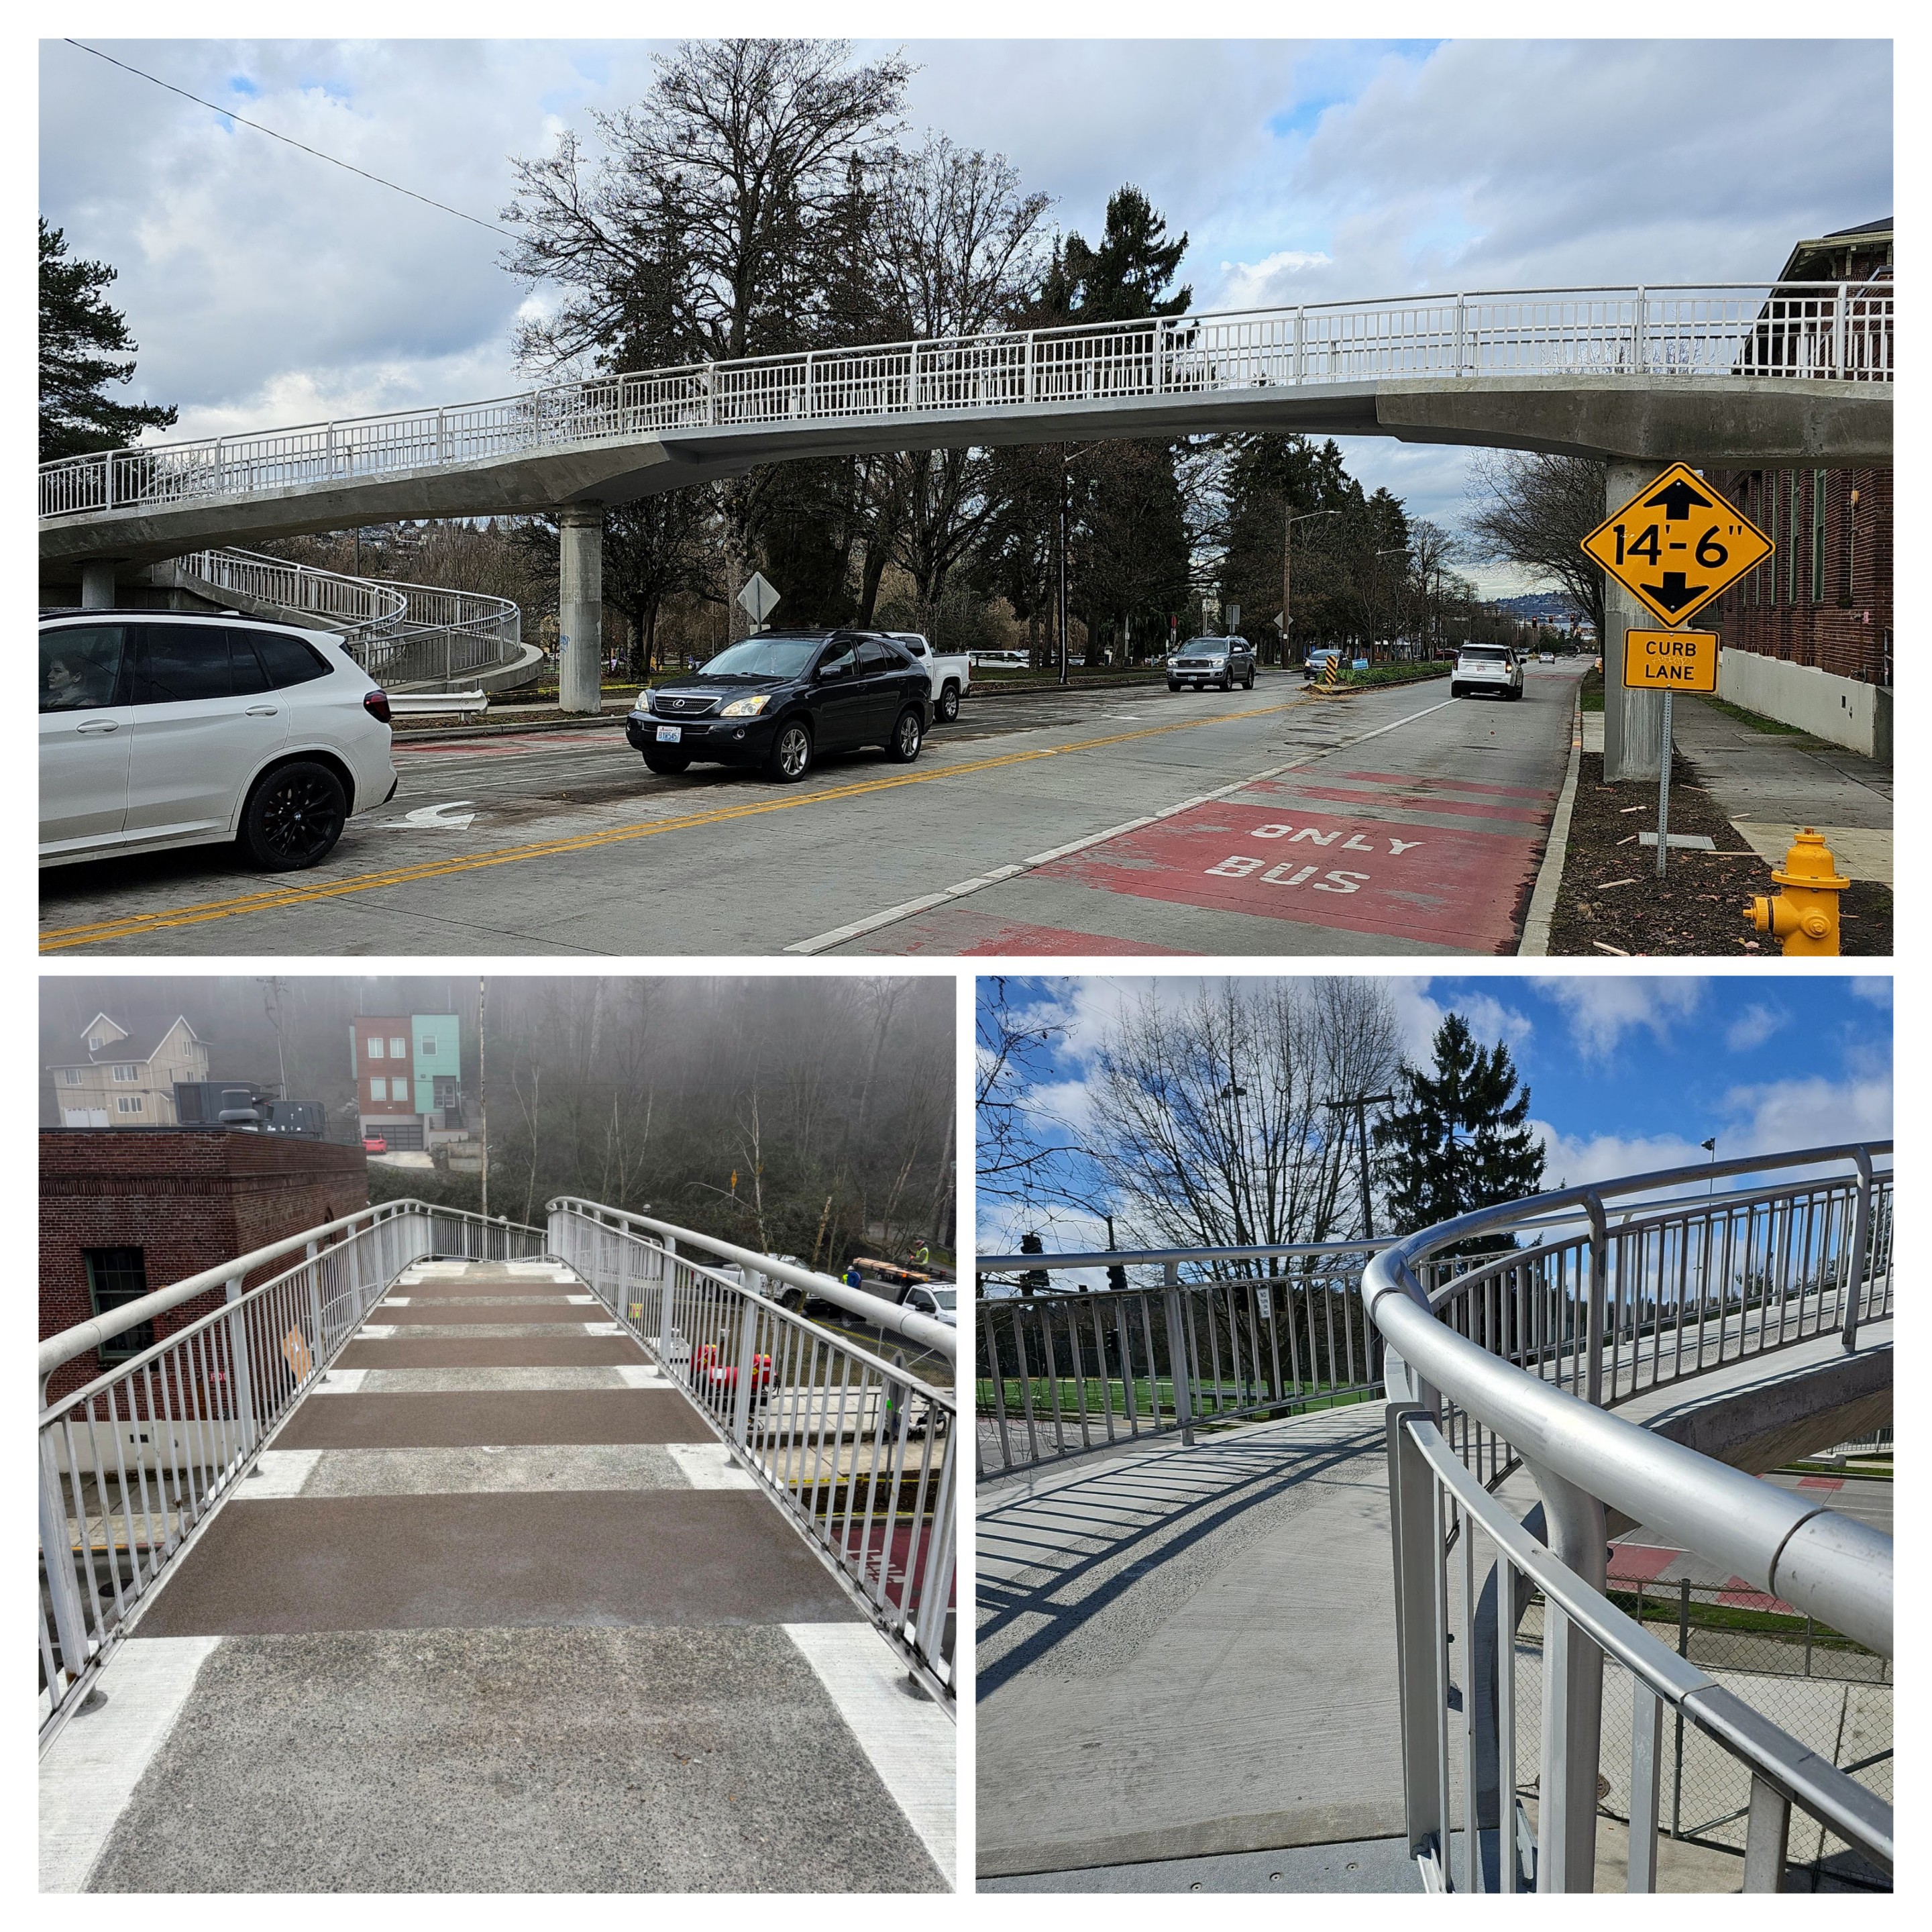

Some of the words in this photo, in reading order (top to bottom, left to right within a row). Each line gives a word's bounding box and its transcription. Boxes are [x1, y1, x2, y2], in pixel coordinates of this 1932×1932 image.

[1646, 641, 1697, 657] CURB
[1645, 664, 1695, 680] LANE
[1250, 824, 1427, 855] ONLY
[1203, 855, 1371, 894] BUS
